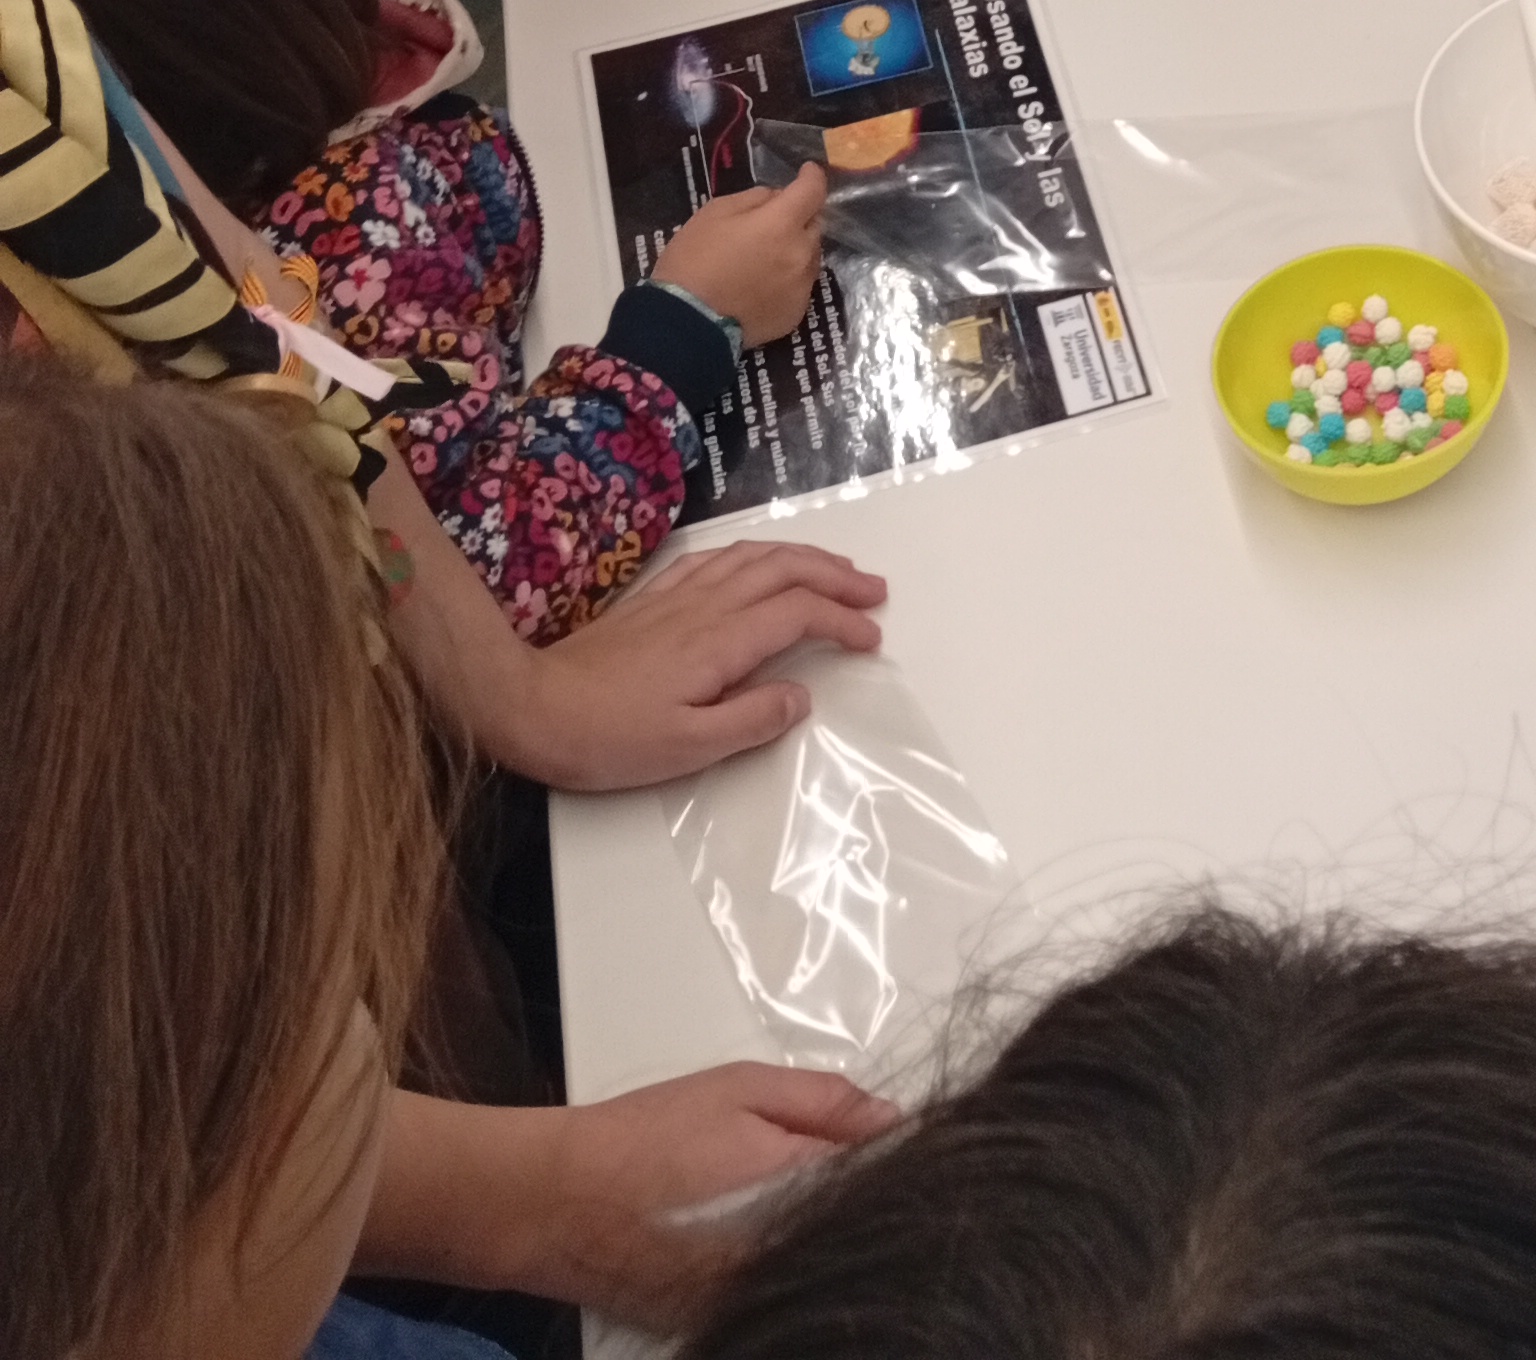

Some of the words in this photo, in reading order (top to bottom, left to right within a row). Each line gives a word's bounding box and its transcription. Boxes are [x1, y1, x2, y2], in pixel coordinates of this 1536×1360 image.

[1008, 74, 1037, 97] el
[1017, 101, 1052, 142] Sol
[1037, 167, 1065, 207] las
[810, 330, 826, 352] del
[825, 305, 849, 367] alrededor
[838, 368, 856, 390] del
[792, 344, 806, 366] ley
[814, 352, 831, 379] Sol.
[1060, 333, 1080, 379] Zaragoza
[1072, 328, 1105, 400] Universidad
[795, 367, 811, 393] que
[820, 380, 835, 407] Sus
[757, 368, 777, 427] estrellas
[703, 411, 716, 433] las
[743, 405, 757, 424] de
[800, 395, 822, 449] permite
[747, 424, 760, 449] las
[764, 427, 779, 438] y
[703, 435, 726, 500] galaxias,
[770, 440, 787, 484] nubes
